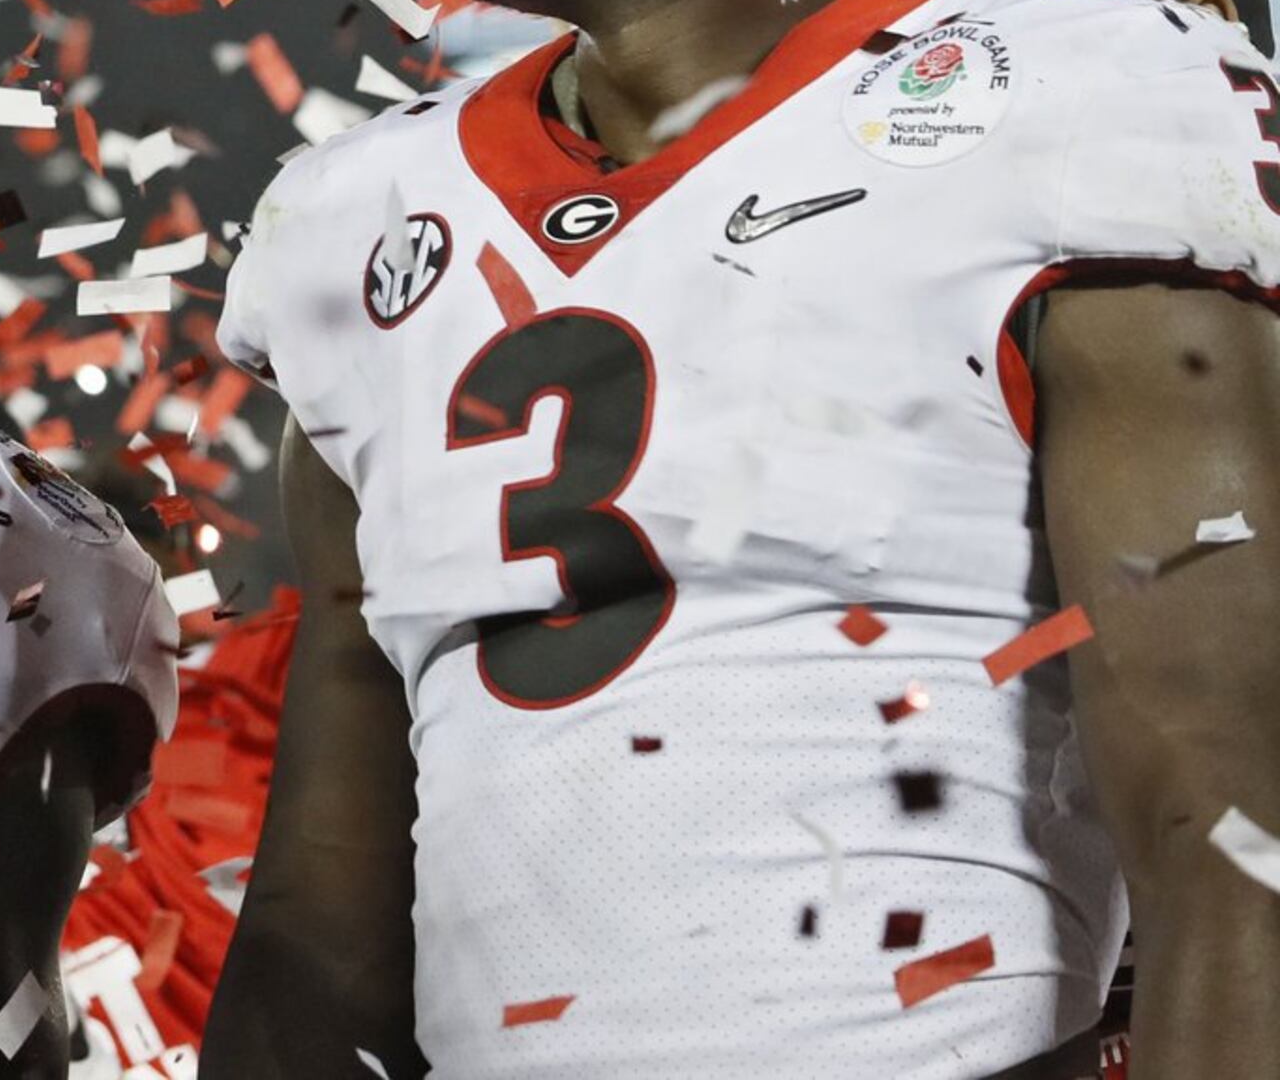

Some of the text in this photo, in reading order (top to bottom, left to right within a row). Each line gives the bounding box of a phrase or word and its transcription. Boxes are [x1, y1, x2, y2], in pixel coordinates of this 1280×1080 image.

[852, 25, 1011, 97] ROSE BOWL GAME
[942, 103, 956, 117] by
[891, 121, 985, 135] Northwestern
[888, 134, 941, 148] Mutual
[446, 306, 677, 710] 3
